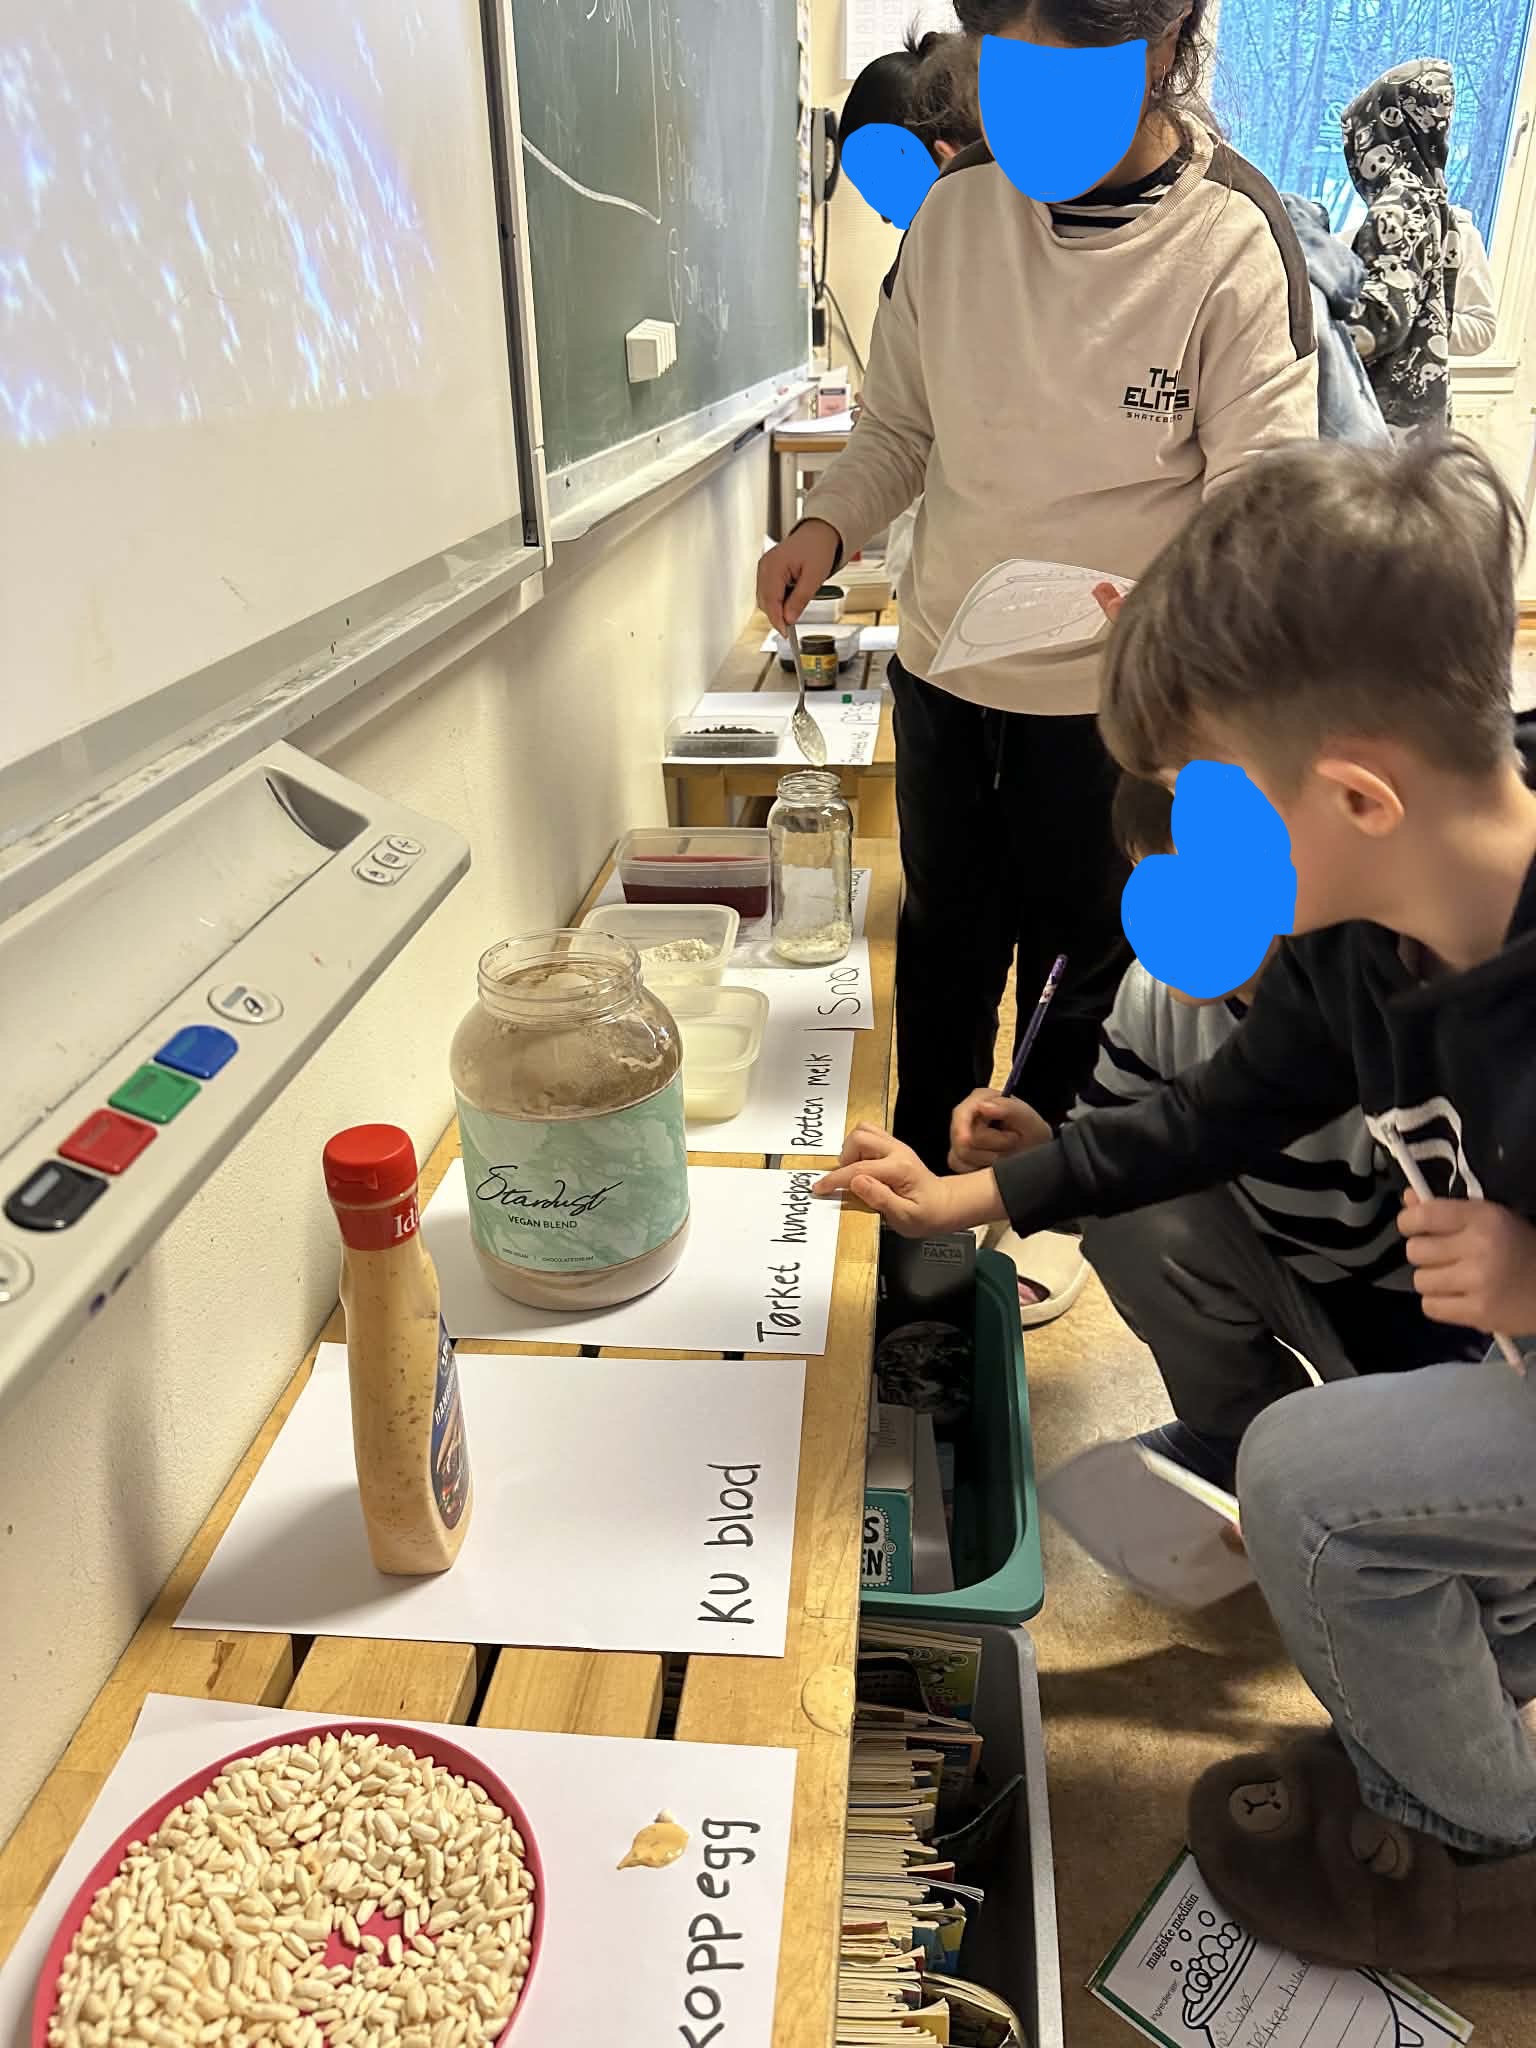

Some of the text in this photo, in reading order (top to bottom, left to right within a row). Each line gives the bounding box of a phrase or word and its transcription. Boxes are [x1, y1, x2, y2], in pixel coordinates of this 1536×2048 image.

[791, 1053, 832, 1147] Rotten melk
[476, 1165, 624, 1217] Stardust
[508, 1214, 578, 1230] VEGAN BLEND
[757, 1262, 802, 1342] Tørket
[703, 1464, 761, 1547] blod
[696, 1818, 761, 1899] egg
[1146, 1893, 1200, 1969] magiske medisin
